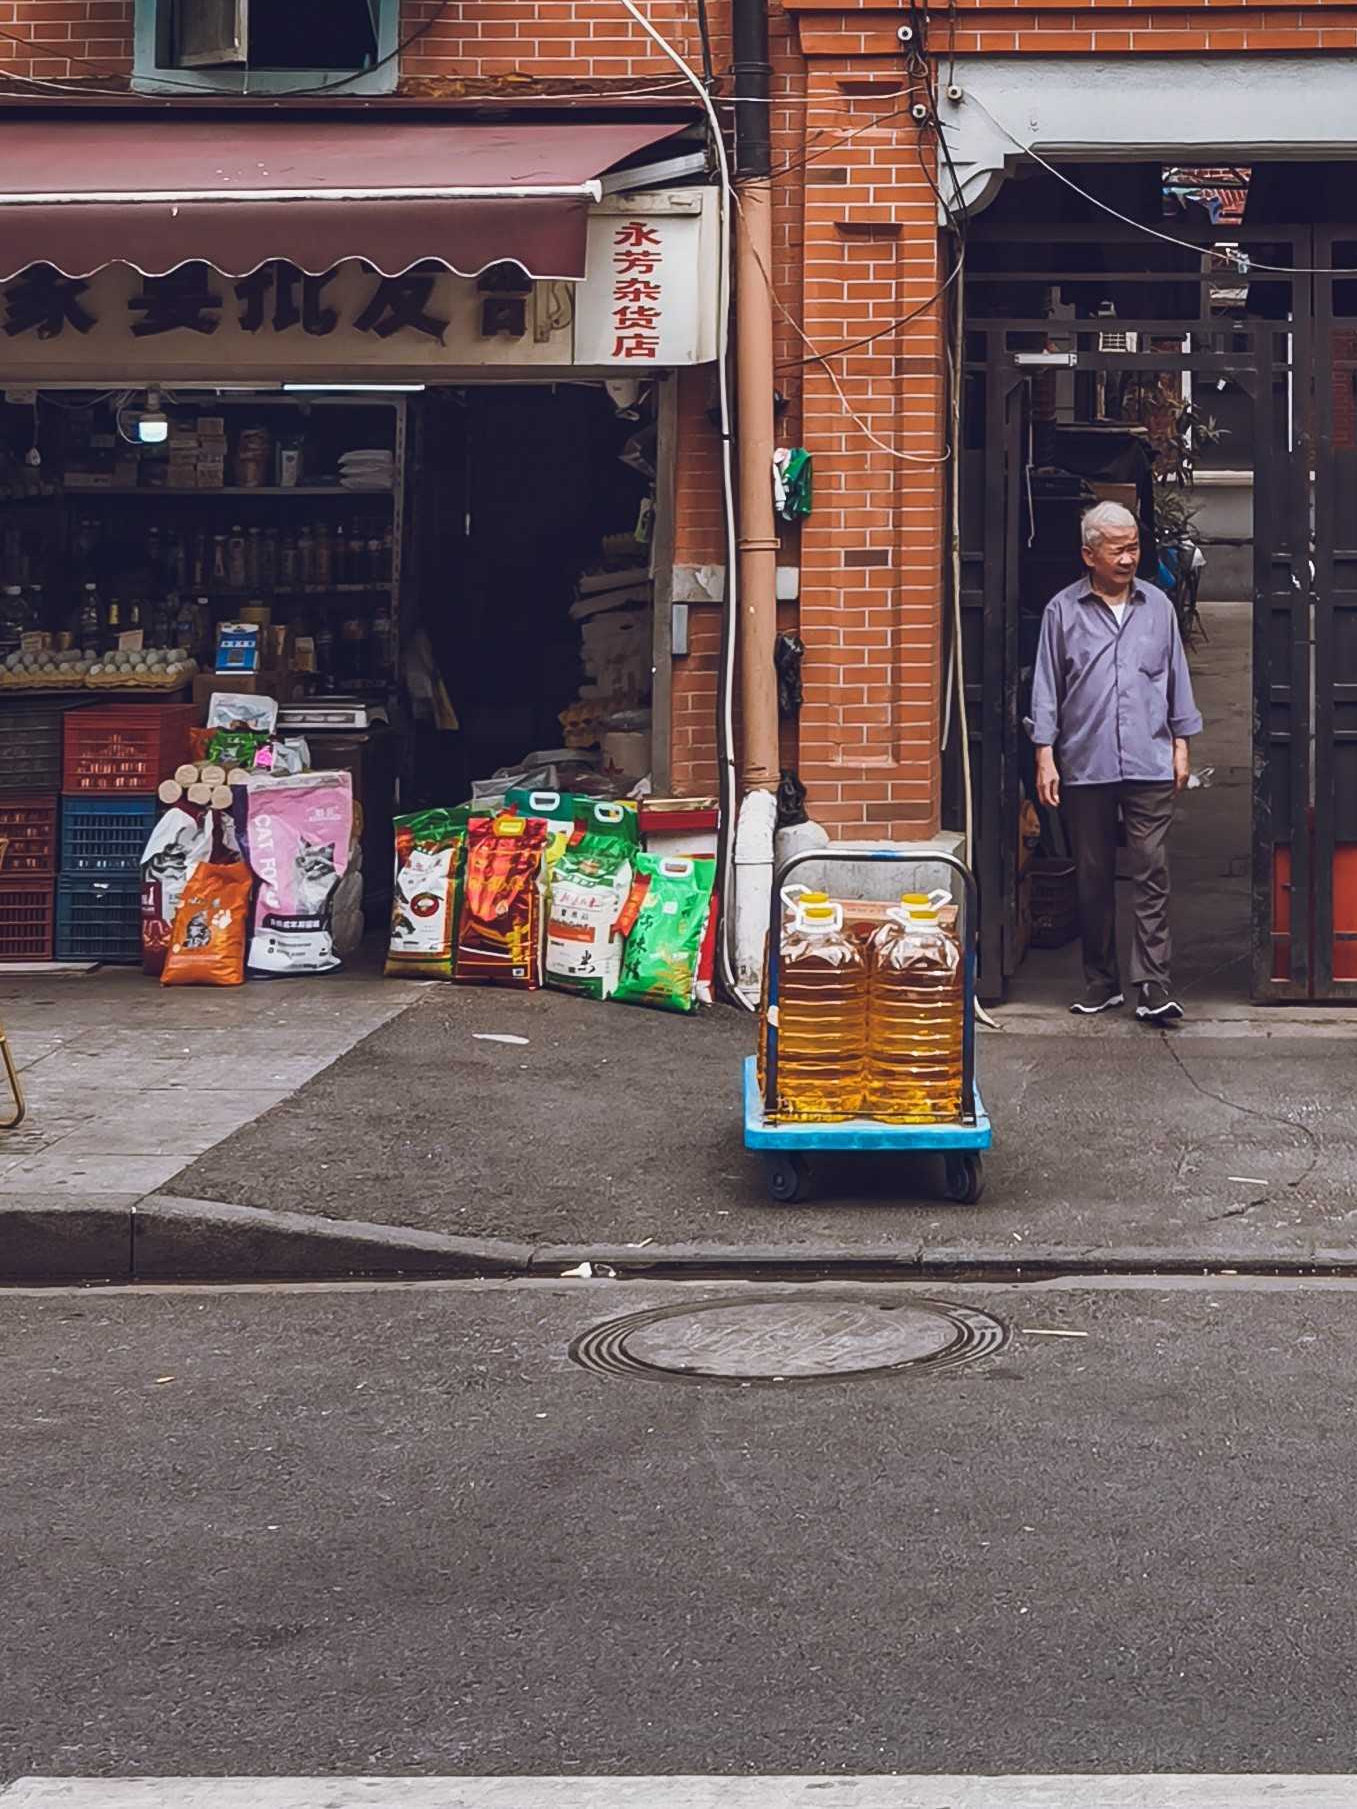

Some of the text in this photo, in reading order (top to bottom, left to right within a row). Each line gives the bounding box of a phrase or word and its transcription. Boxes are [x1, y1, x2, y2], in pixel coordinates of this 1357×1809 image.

[612, 221, 663, 359] 永芳杂货店
[254, 814, 273, 849] CAT
